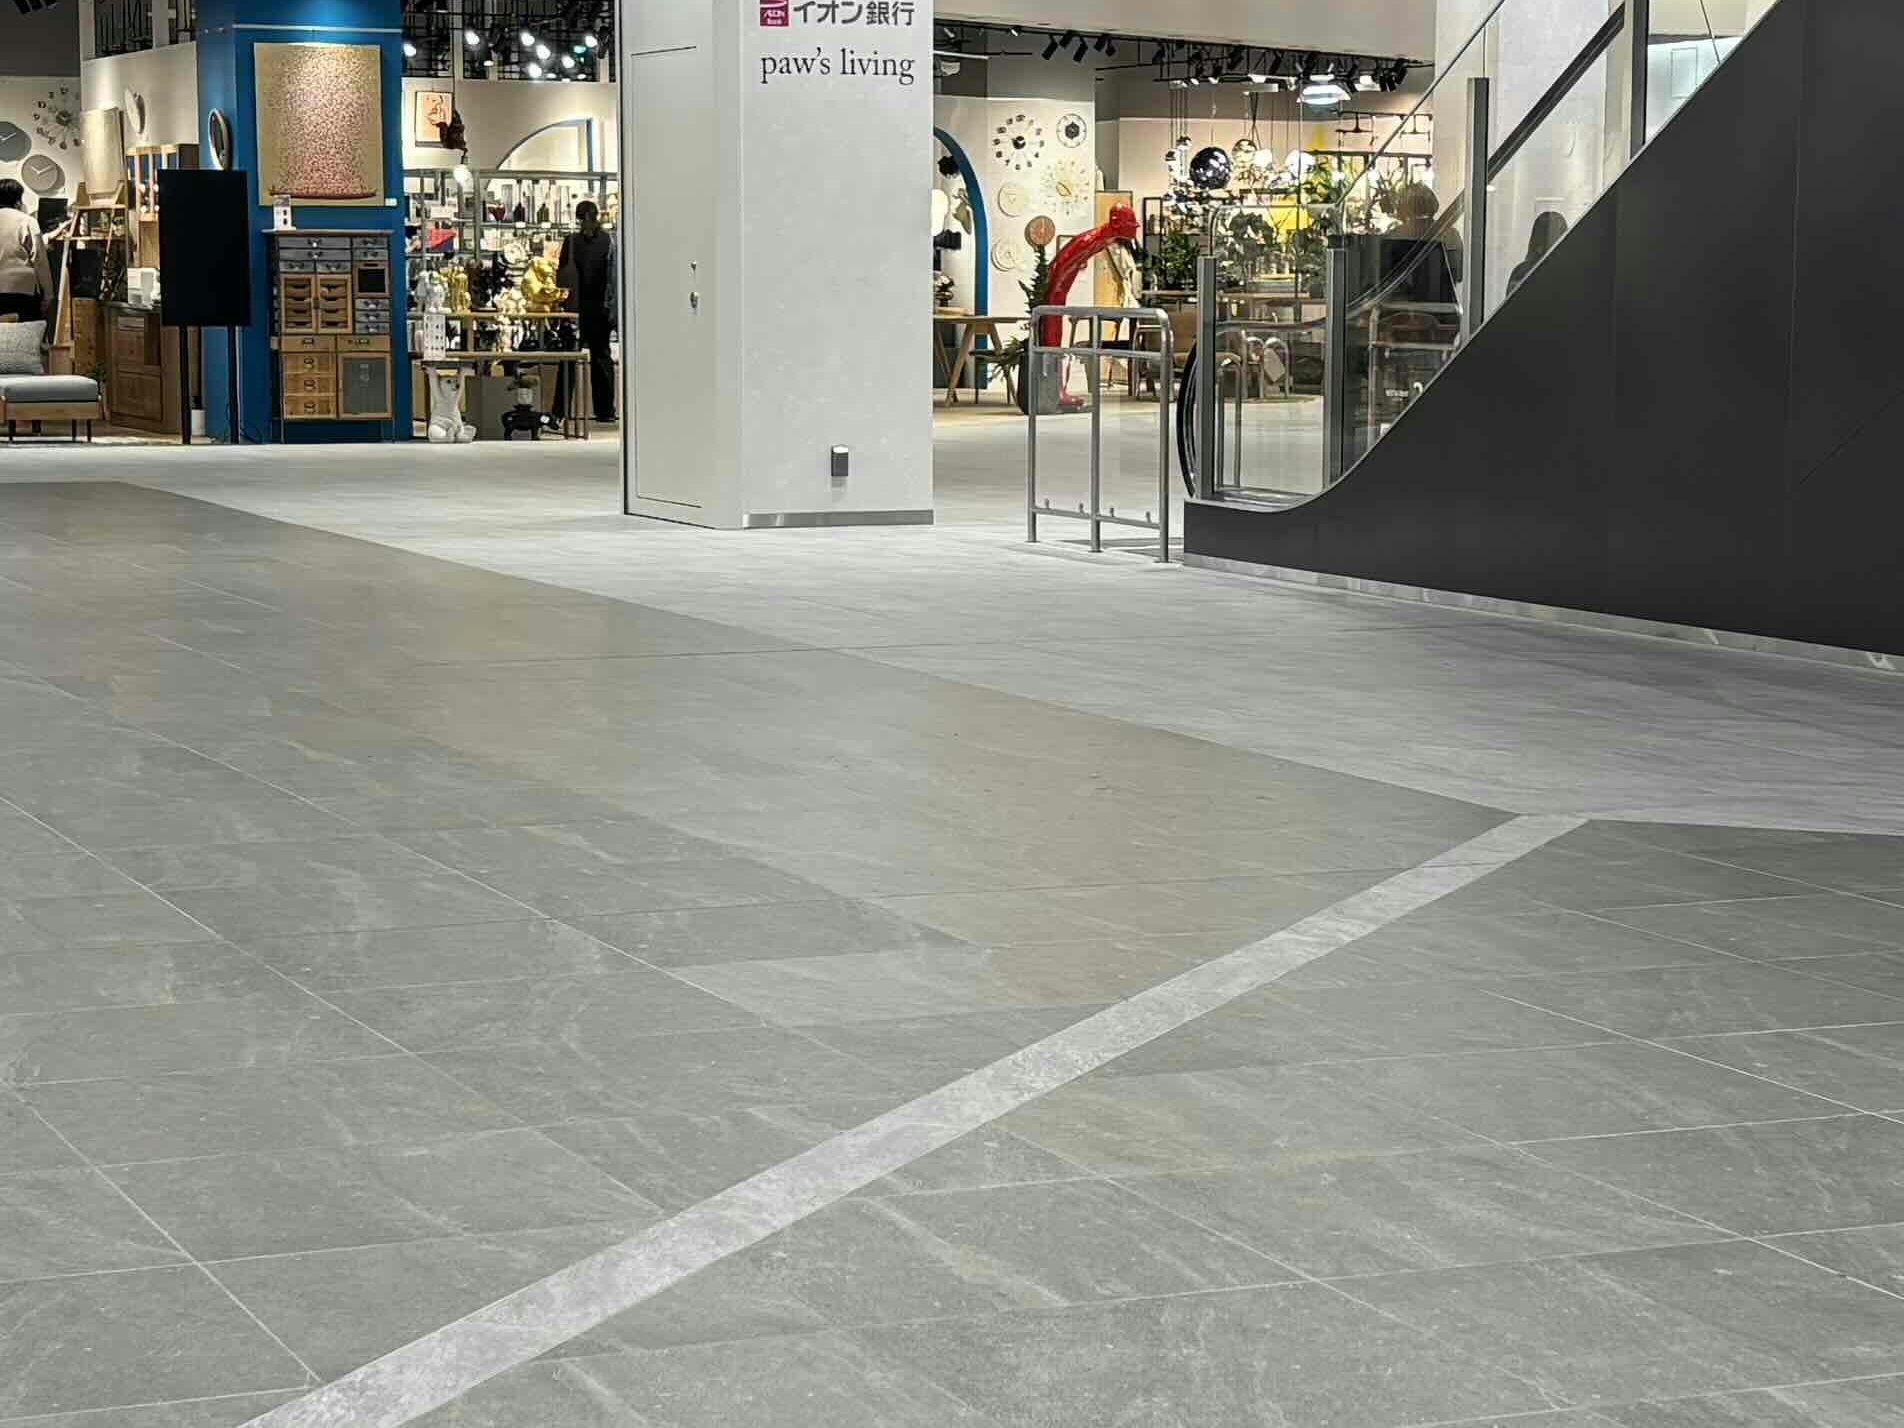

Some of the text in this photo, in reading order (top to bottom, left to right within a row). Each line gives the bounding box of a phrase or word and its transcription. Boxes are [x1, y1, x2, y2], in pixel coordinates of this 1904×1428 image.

[793, 0, 915, 26] イオン銀行
[760, 46, 916, 86] paw's living
